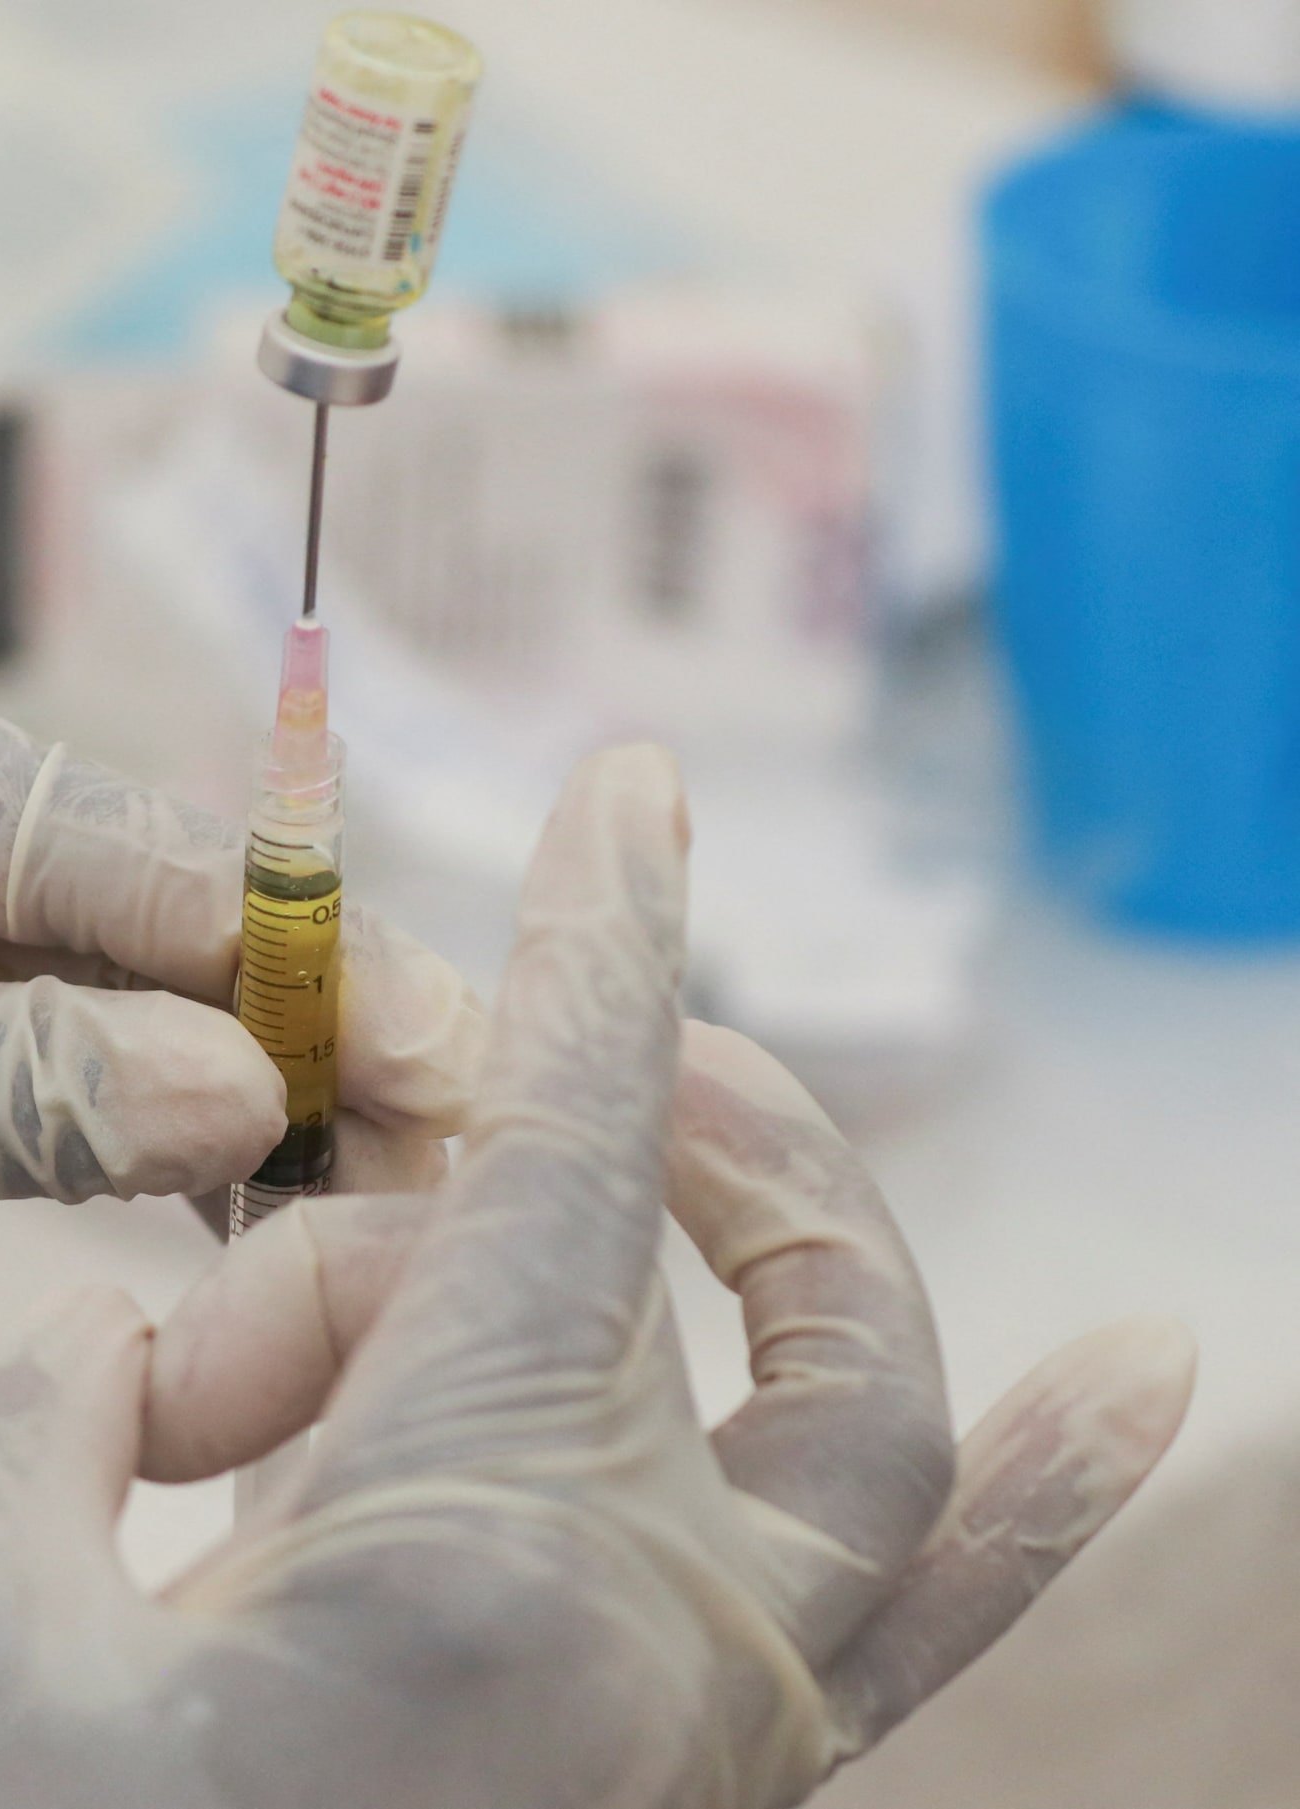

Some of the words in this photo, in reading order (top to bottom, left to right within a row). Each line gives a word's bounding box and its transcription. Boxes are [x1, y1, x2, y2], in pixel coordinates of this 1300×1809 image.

[312, 897, 341, 925] 0.5
[312, 975, 323, 994] 1
[309, 1036, 335, 1063] 1.5
